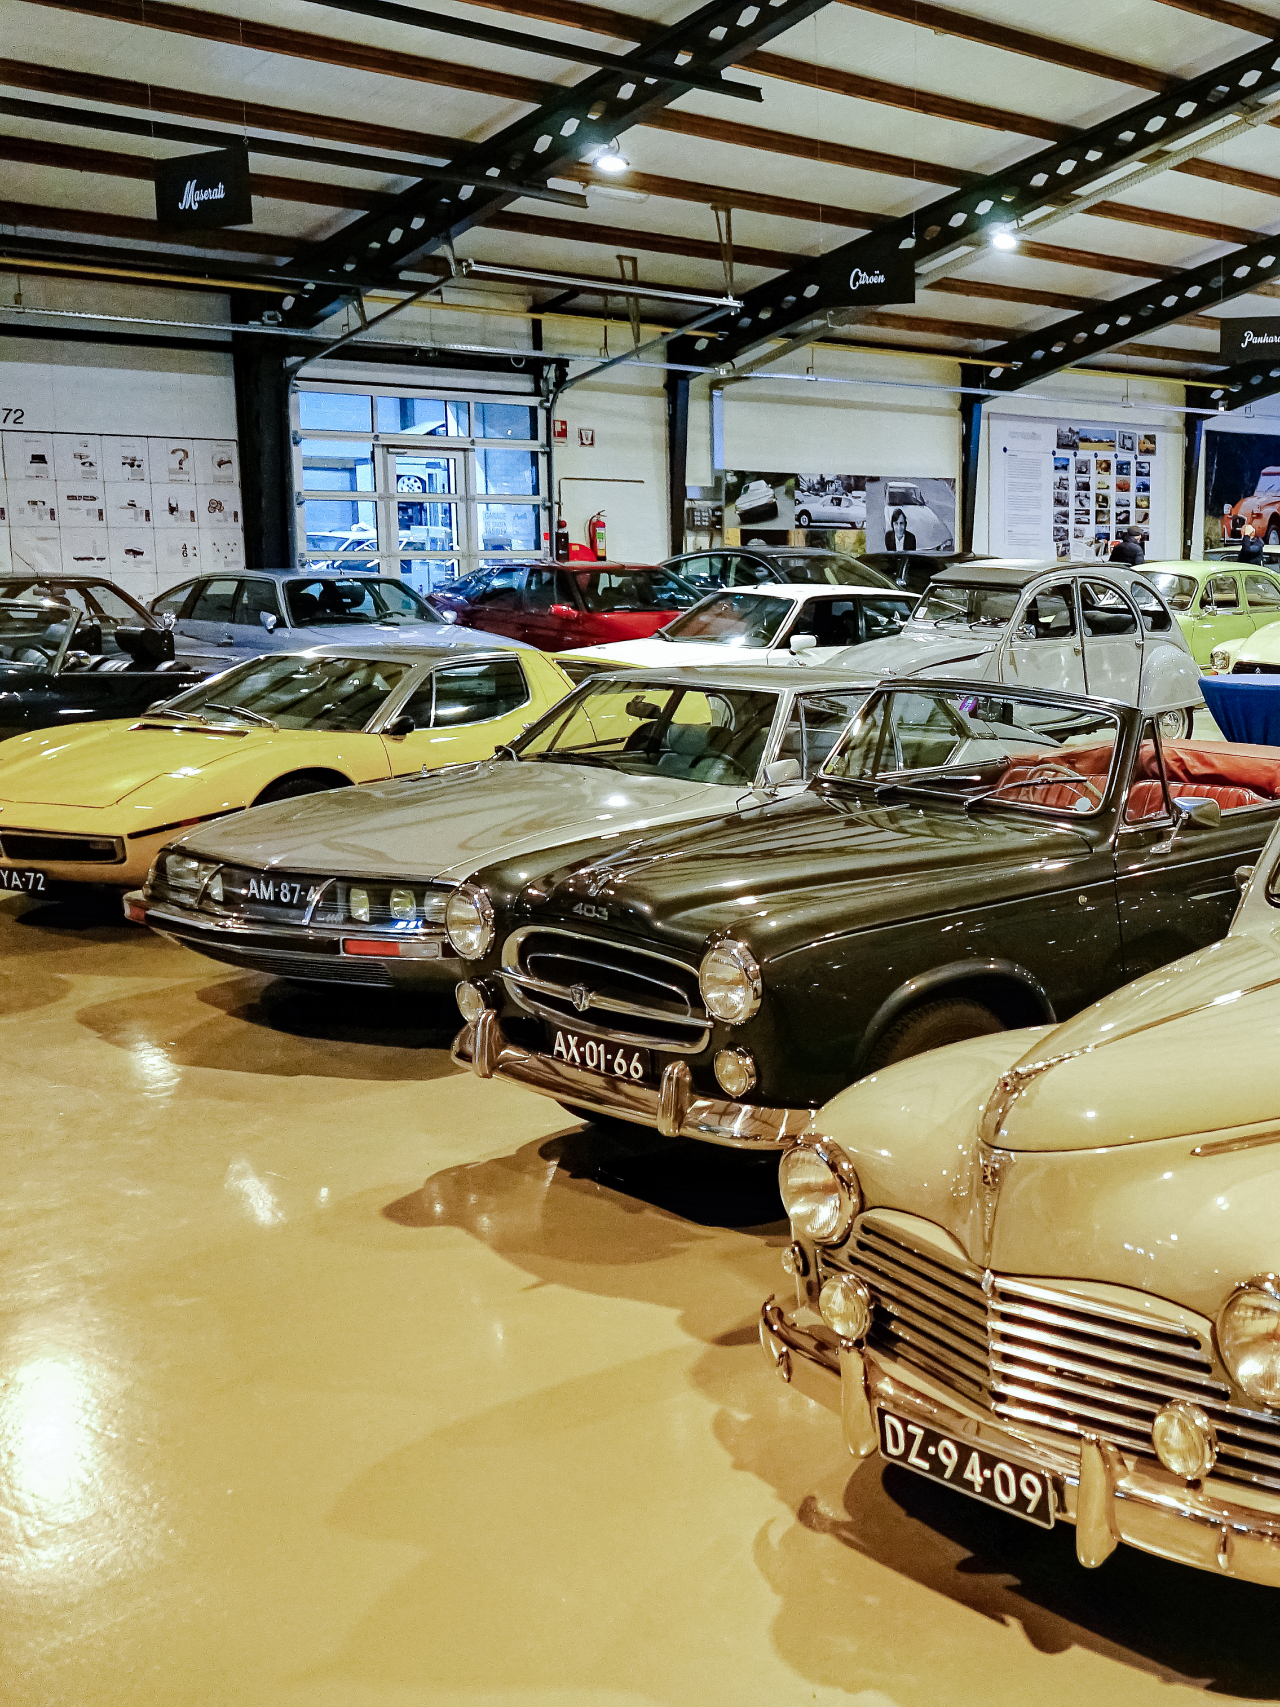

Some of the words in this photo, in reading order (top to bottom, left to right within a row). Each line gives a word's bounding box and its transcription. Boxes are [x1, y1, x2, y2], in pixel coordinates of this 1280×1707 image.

[178, 179, 226, 210] Maserati
[849, 267, 886, 290] Citroën
[884, 1413, 1043, 1514] DZ-94-09
